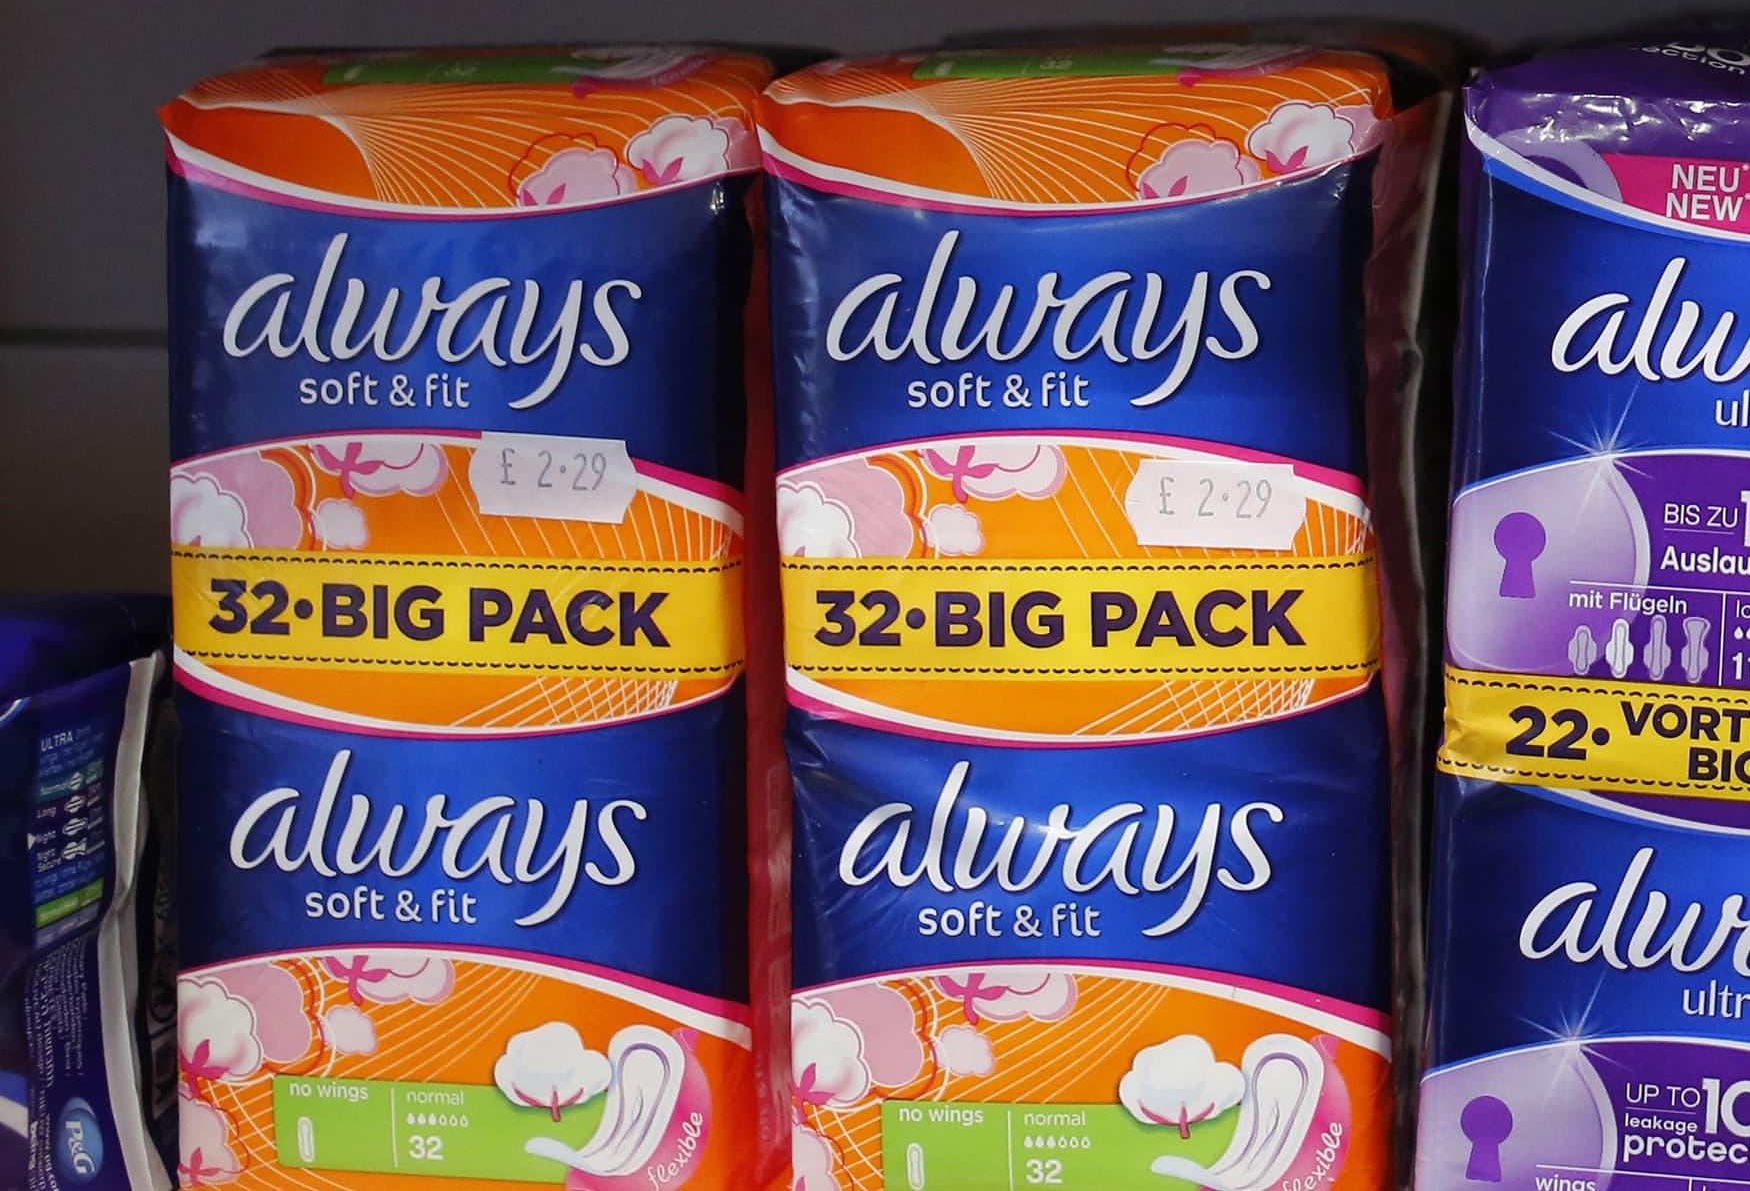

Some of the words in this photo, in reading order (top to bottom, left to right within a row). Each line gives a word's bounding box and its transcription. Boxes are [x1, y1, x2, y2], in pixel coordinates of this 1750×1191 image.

[222, 232, 642, 410] always
[826, 230, 1271, 408] always
[300, 372, 379, 407] soft
[388, 375, 416, 407] &
[424, 373, 470, 409] fit
[907, 372, 992, 408] soft
[1002, 373, 1032, 408] &
[1041, 371, 1089, 408] fit
[500, 449, 516, 486] £
[1159, 478, 1175, 515] £
[1664, 503, 1700, 526] BIS
[1706, 506, 1739, 529] ZU
[467, 588, 671, 649] PACK
[1090, 589, 1305, 647] PACK
[1568, 589, 1604, 610] mit
[1609, 592, 1688, 616] Flügeln
[41, 731, 73, 751] ULTRA
[229, 749, 647, 927] always
[838, 761, 1284, 937] always
[305, 886, 384, 922] soft
[395, 890, 423, 923] &
[431, 890, 477, 924] fit
[918, 902, 1002, 937] soft
[1012, 905, 1043, 937] &
[1051, 902, 1101, 937] fit
[289, 1082, 312, 1098] no
[317, 1081, 369, 1103] wings
[406, 1088, 464, 1106] normal
[1625, 1082, 1661, 1105] UP
[1664, 1085, 1701, 1108] TO
[899, 1109, 923, 1122] no
[928, 1107, 984, 1128] wings
[1023, 1111, 1086, 1127] normal
[1624, 1112, 1698, 1136] leakage
[64, 1119, 96, 1176] P&G
[408, 1136, 444, 1161] 32
[647, 1112, 703, 1191] flexible
[1025, 1159, 1063, 1184] 32
